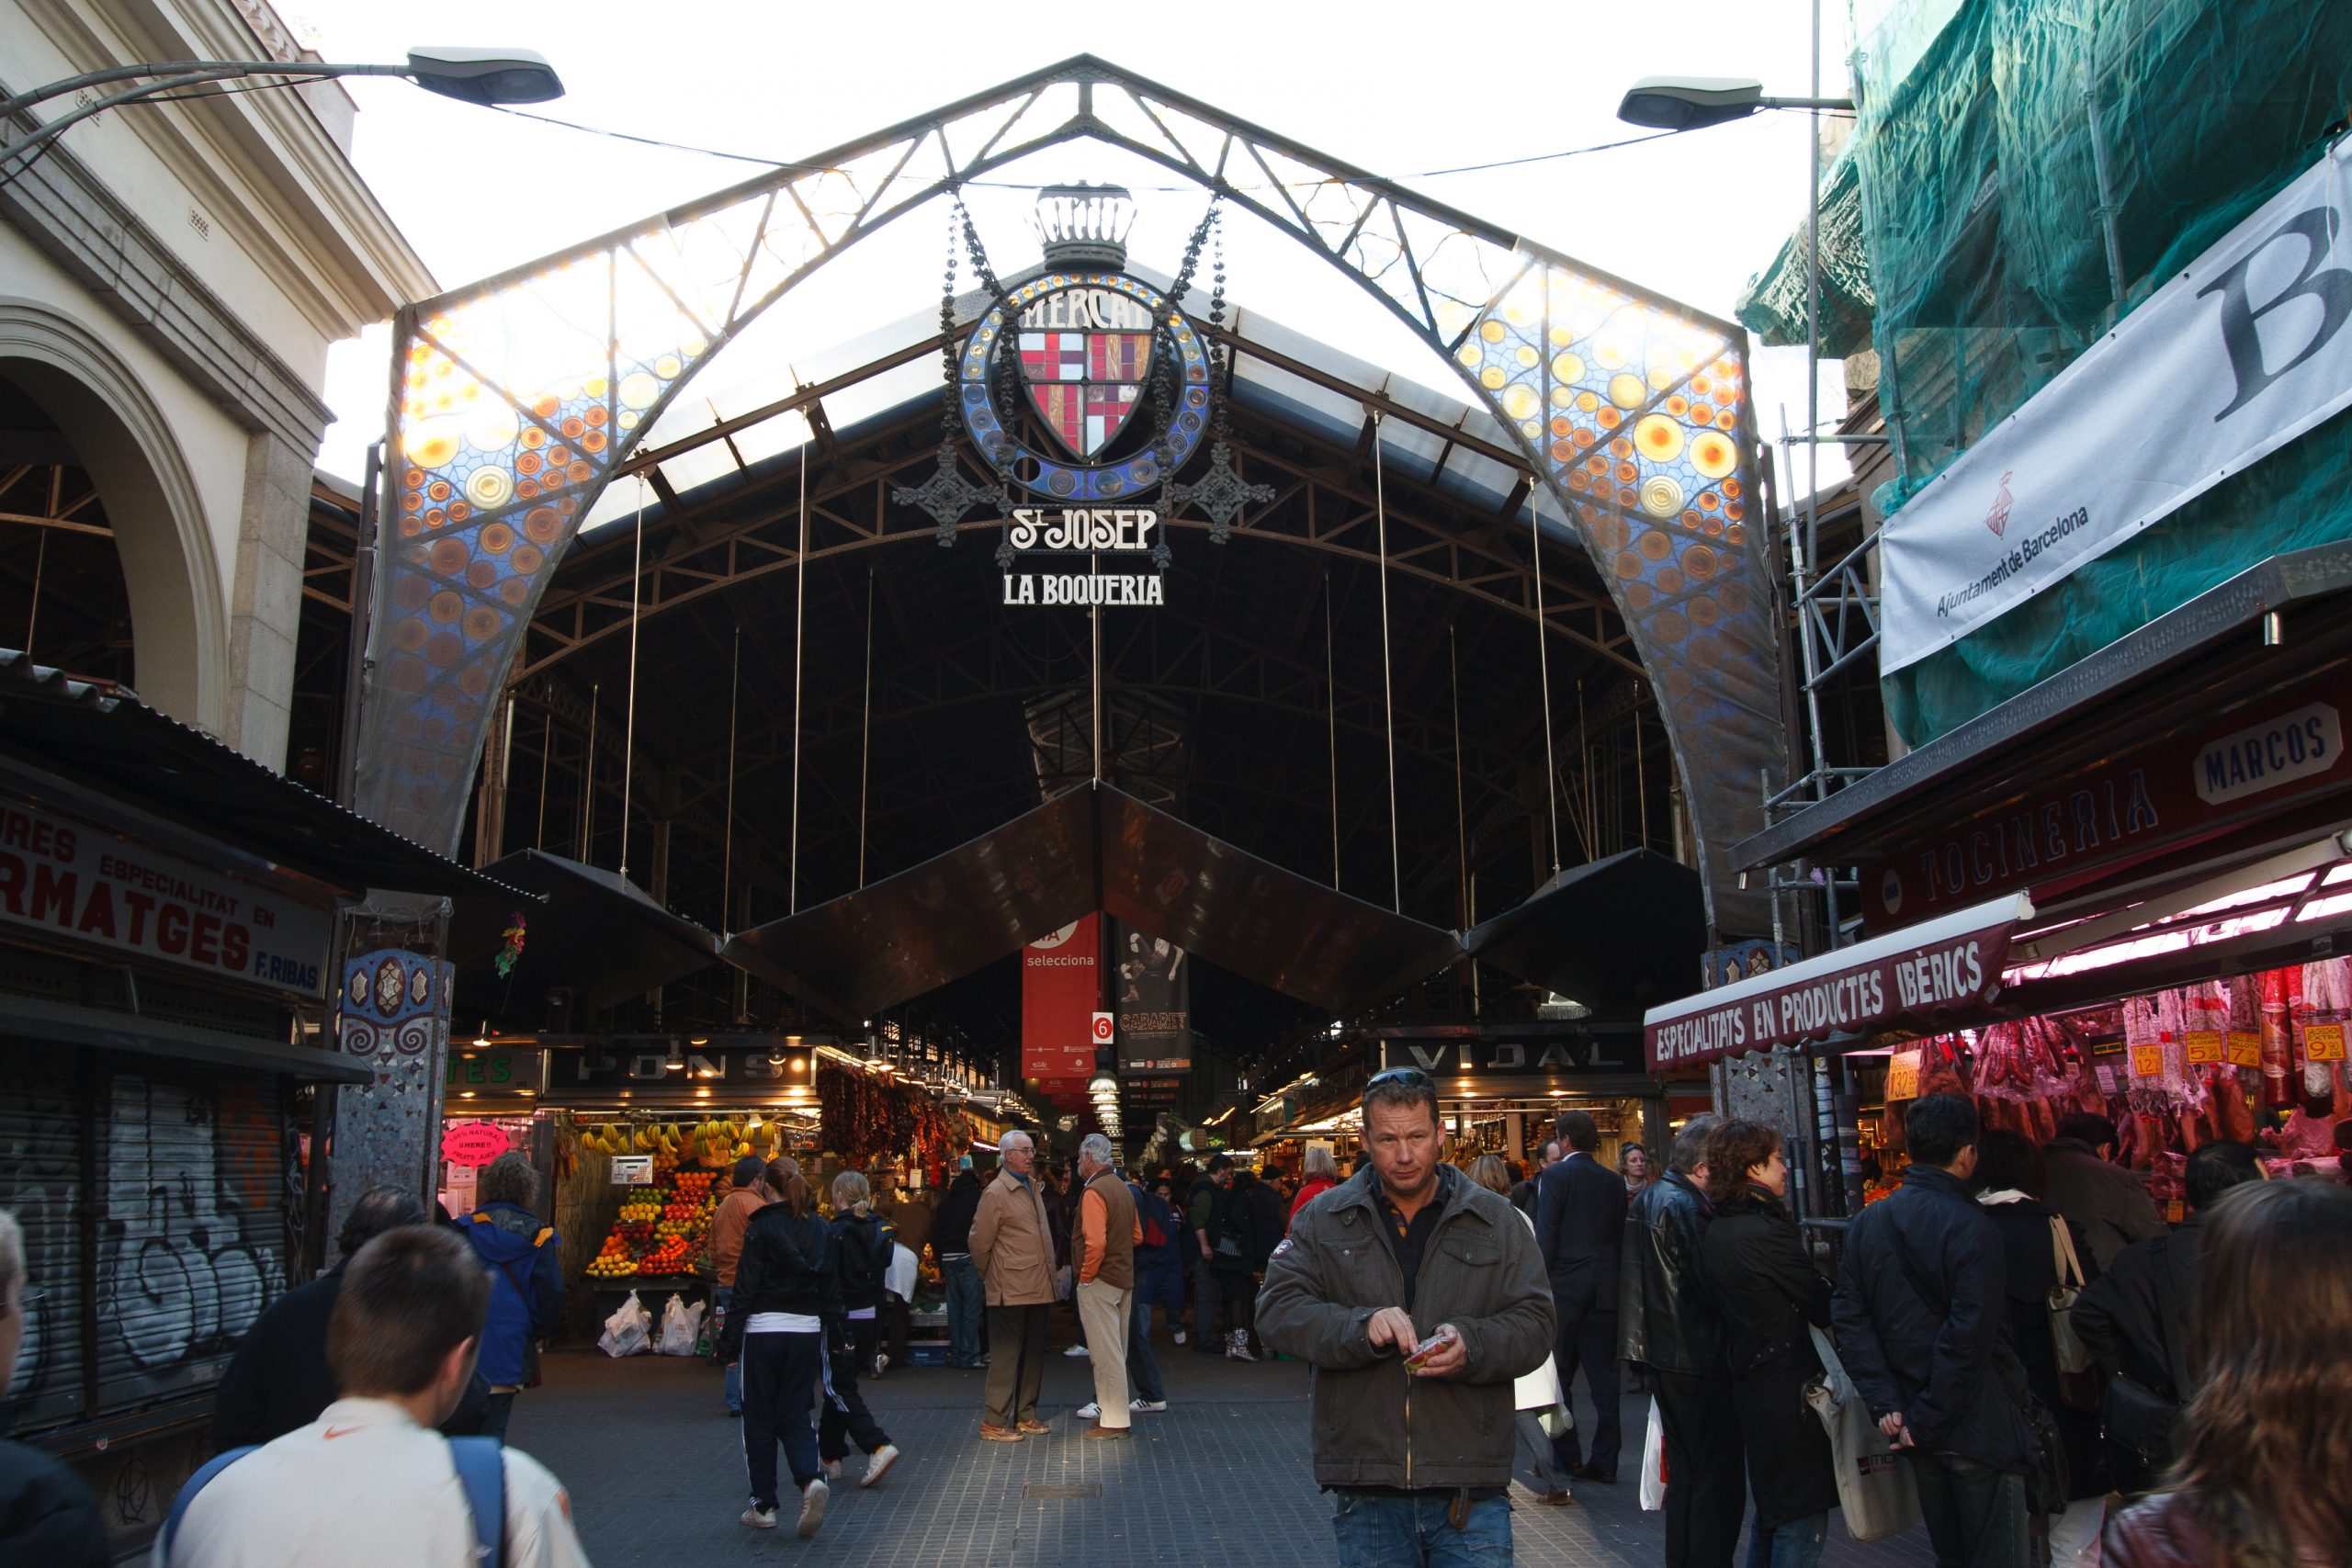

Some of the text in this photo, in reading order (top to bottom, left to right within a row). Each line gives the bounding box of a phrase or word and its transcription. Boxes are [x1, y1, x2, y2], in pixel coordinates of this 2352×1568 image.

[1023, 288, 1150, 329] MERCAT
[1044, 509, 1157, 549] JOSEP
[1937, 506, 2089, 617] Ajuntament de Barcelona
[1003, 574, 1164, 604] LA BOQUERIA
[2205, 716, 2325, 793] MARCOS
[0, 807, 76, 863] RES
[1920, 767, 2158, 902] TOCINERIA
[100, 854, 275, 929] ESPECIALITAT EN
[1027, 954, 1094, 966] selecciona
[1657, 941, 1983, 1062] ESPECIALITATS EN PRODUCTES IBÈRICS
[1098, 1021, 1107, 1036] 6
[1119, 1012, 1187, 1032] CABARET
[1408, 1043, 1623, 1070] VIDAL
[452, 1150, 496, 1160] FRUITS JUICE
[469, 1130, 501, 1143] NATURAL
